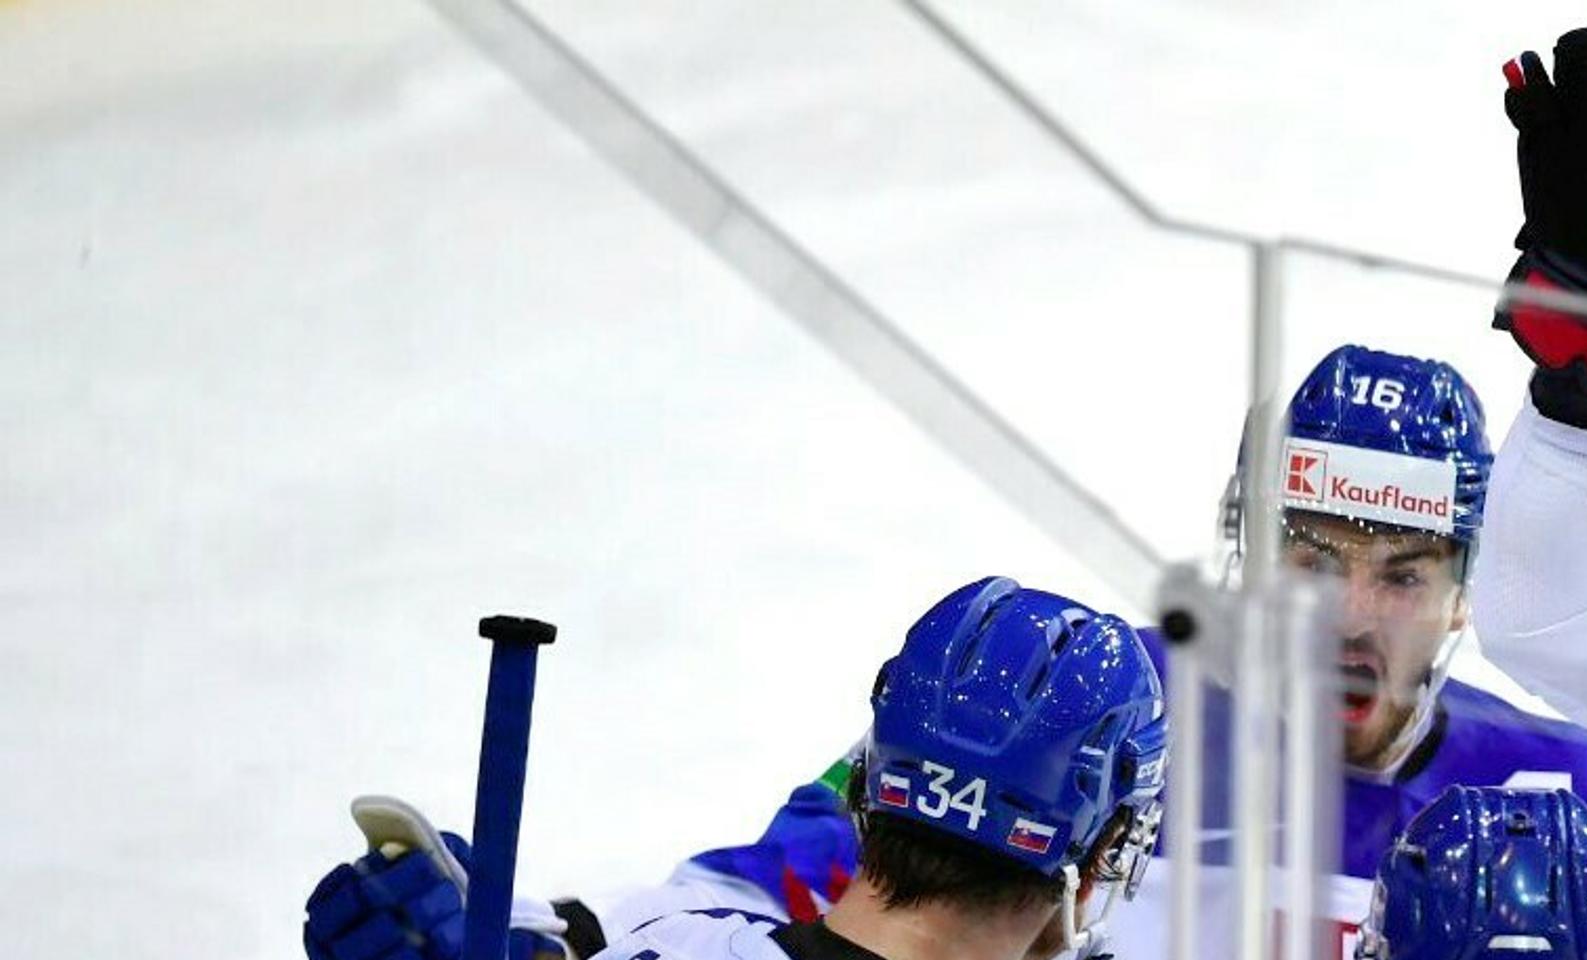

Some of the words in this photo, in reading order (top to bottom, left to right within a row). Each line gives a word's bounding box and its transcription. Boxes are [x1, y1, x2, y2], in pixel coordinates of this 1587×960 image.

[1351, 376, 1405, 410] 16
[1331, 476, 1449, 518] Kaufland
[916, 760, 987, 830] 34
